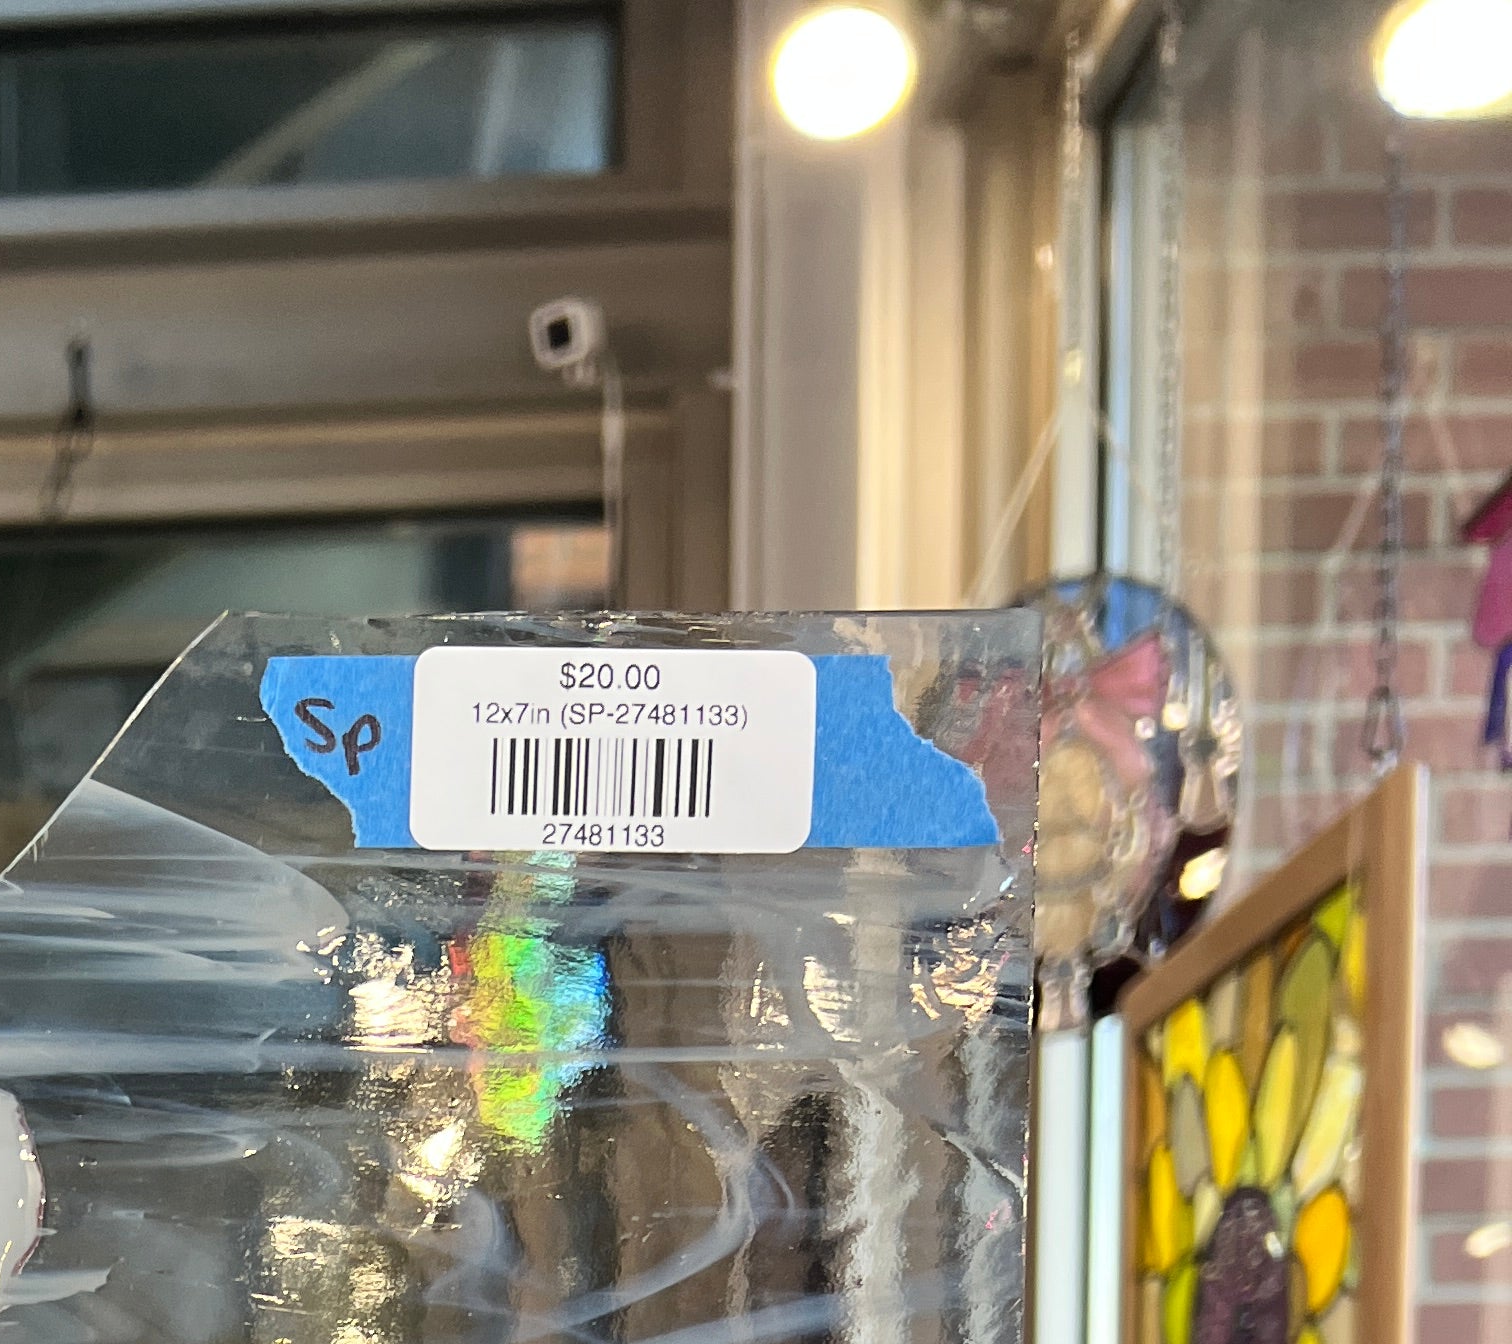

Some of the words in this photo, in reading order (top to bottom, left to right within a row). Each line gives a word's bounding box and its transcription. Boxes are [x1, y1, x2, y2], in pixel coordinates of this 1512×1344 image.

[559, 662, 662, 692] $20.00
[472, 702, 551, 726] 12x7in
[560, 702, 749, 731] (SP-27481133)
[541, 822, 666, 848] 27481133
